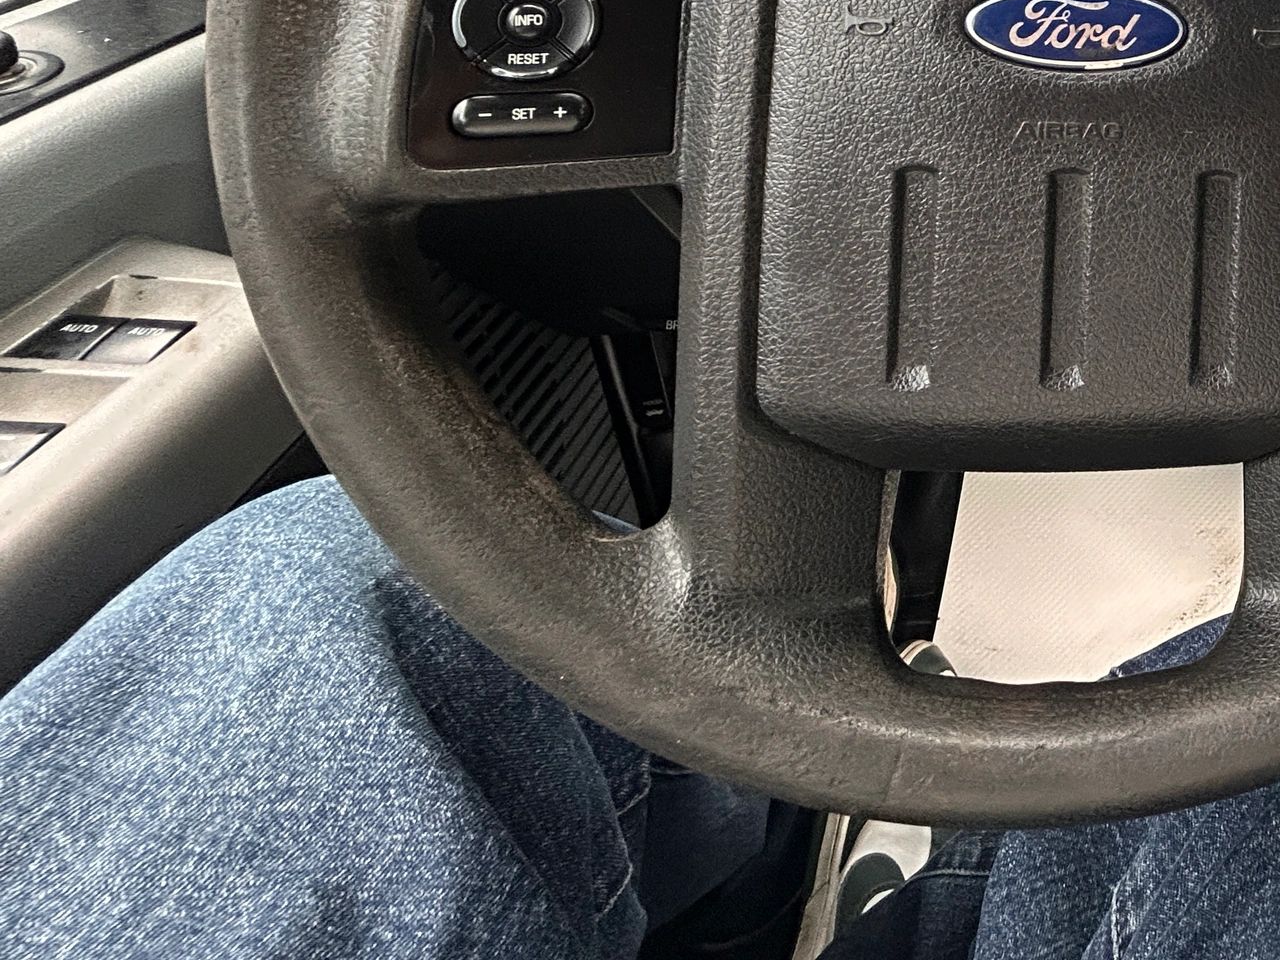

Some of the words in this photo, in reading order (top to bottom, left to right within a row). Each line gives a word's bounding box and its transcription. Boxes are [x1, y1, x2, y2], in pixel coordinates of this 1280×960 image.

[514, 14, 543, 26] INFO
[507, 52, 549, 65] RESET
[511, 108, 536, 120] SET
[1013, 120, 1124, 141] AIRBAG
[59, 323, 99, 334] AUTO
[128, 326, 166, 337] AUTO
